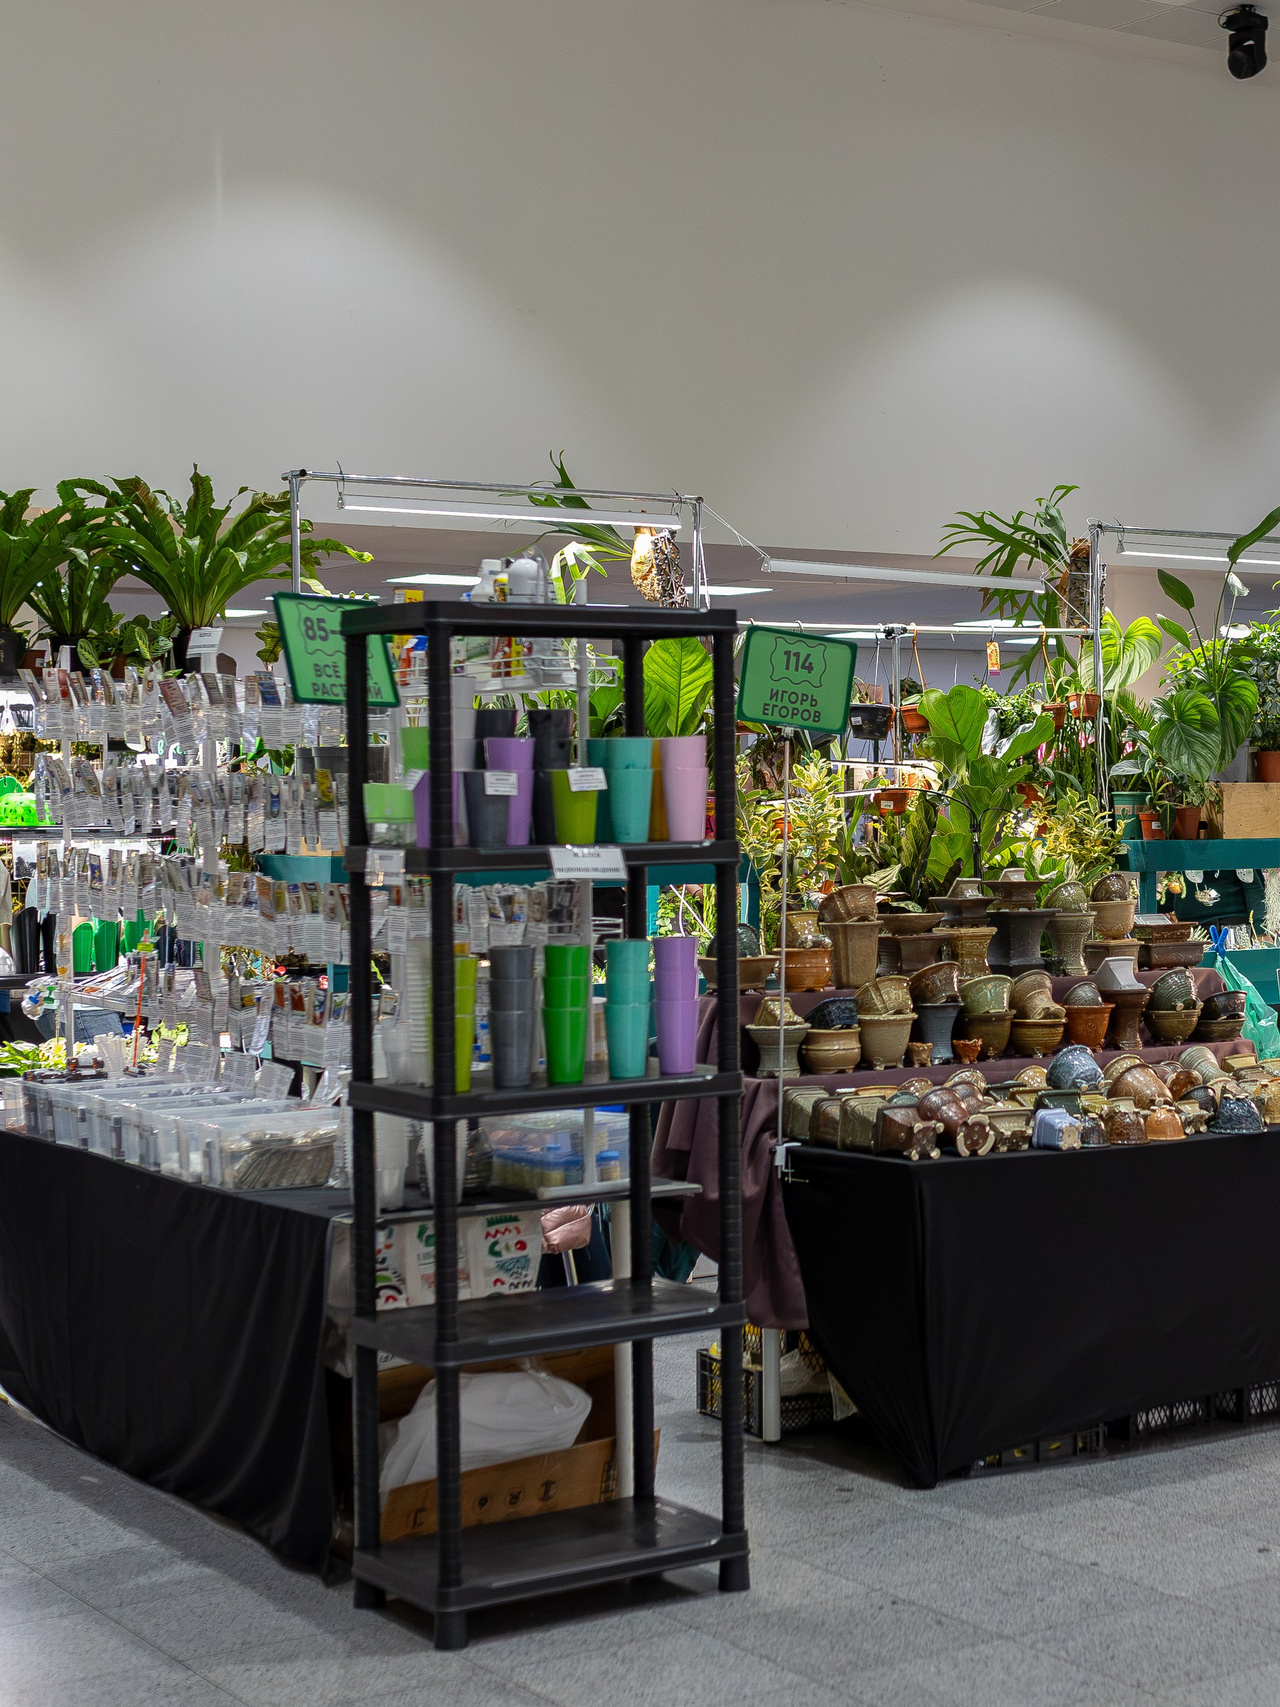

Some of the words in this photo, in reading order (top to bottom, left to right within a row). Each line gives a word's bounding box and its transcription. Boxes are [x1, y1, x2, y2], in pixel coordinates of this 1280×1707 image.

[312, 661, 342, 679] ВСЁ
[783, 649, 814, 675] 114
[769, 688, 819, 708] ИГОРЬ
[762, 702, 822, 724] ЕГОРОВ
